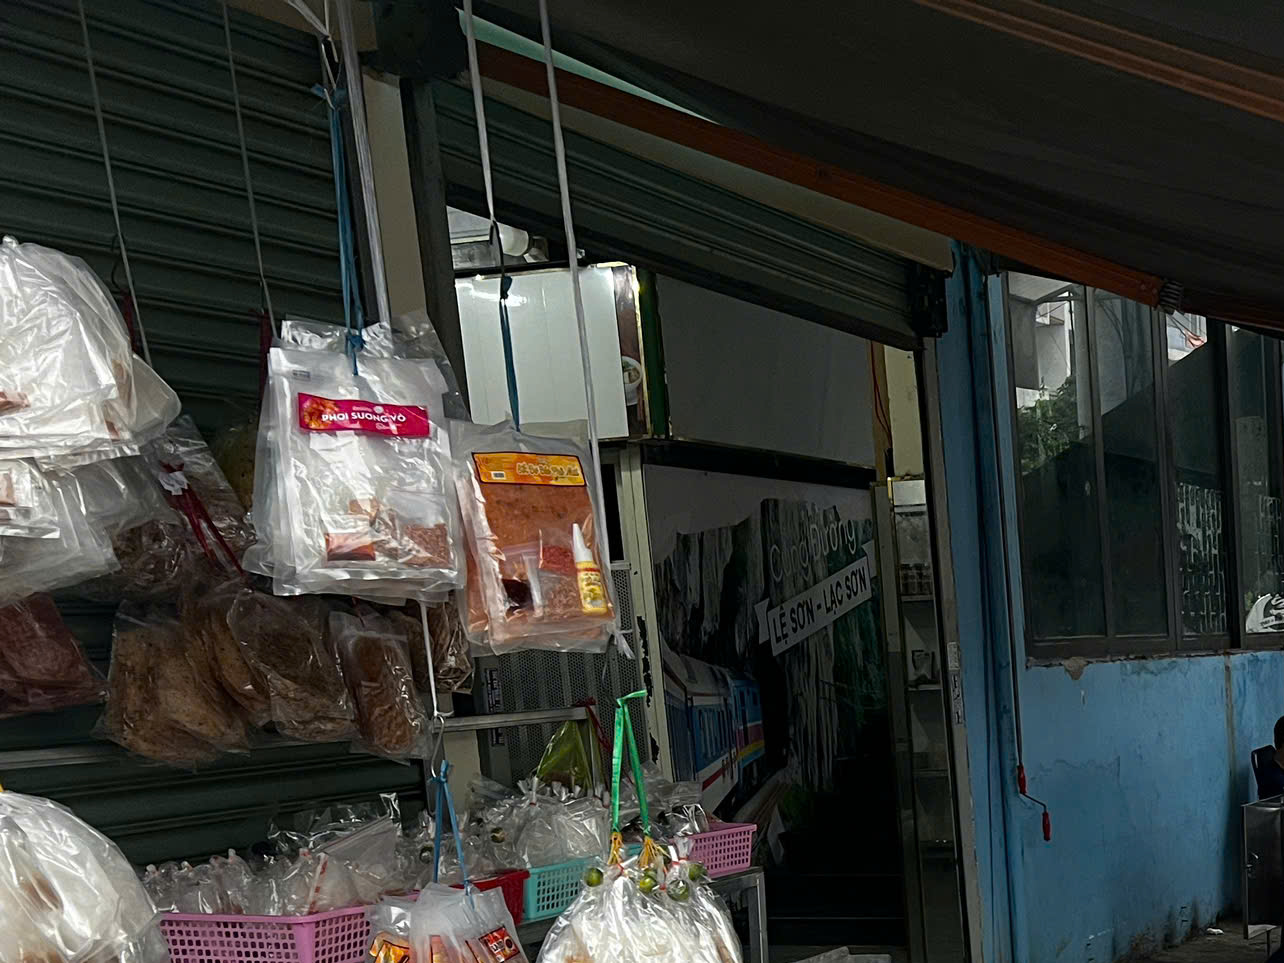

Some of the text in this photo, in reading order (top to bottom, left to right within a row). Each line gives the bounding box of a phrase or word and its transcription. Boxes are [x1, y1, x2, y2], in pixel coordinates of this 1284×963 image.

[772, 606, 789, 645] LỆ
[790, 597, 815, 634] SƠN
[823, 580, 844, 615] LẠC
[845, 566, 867, 598] SƠN
